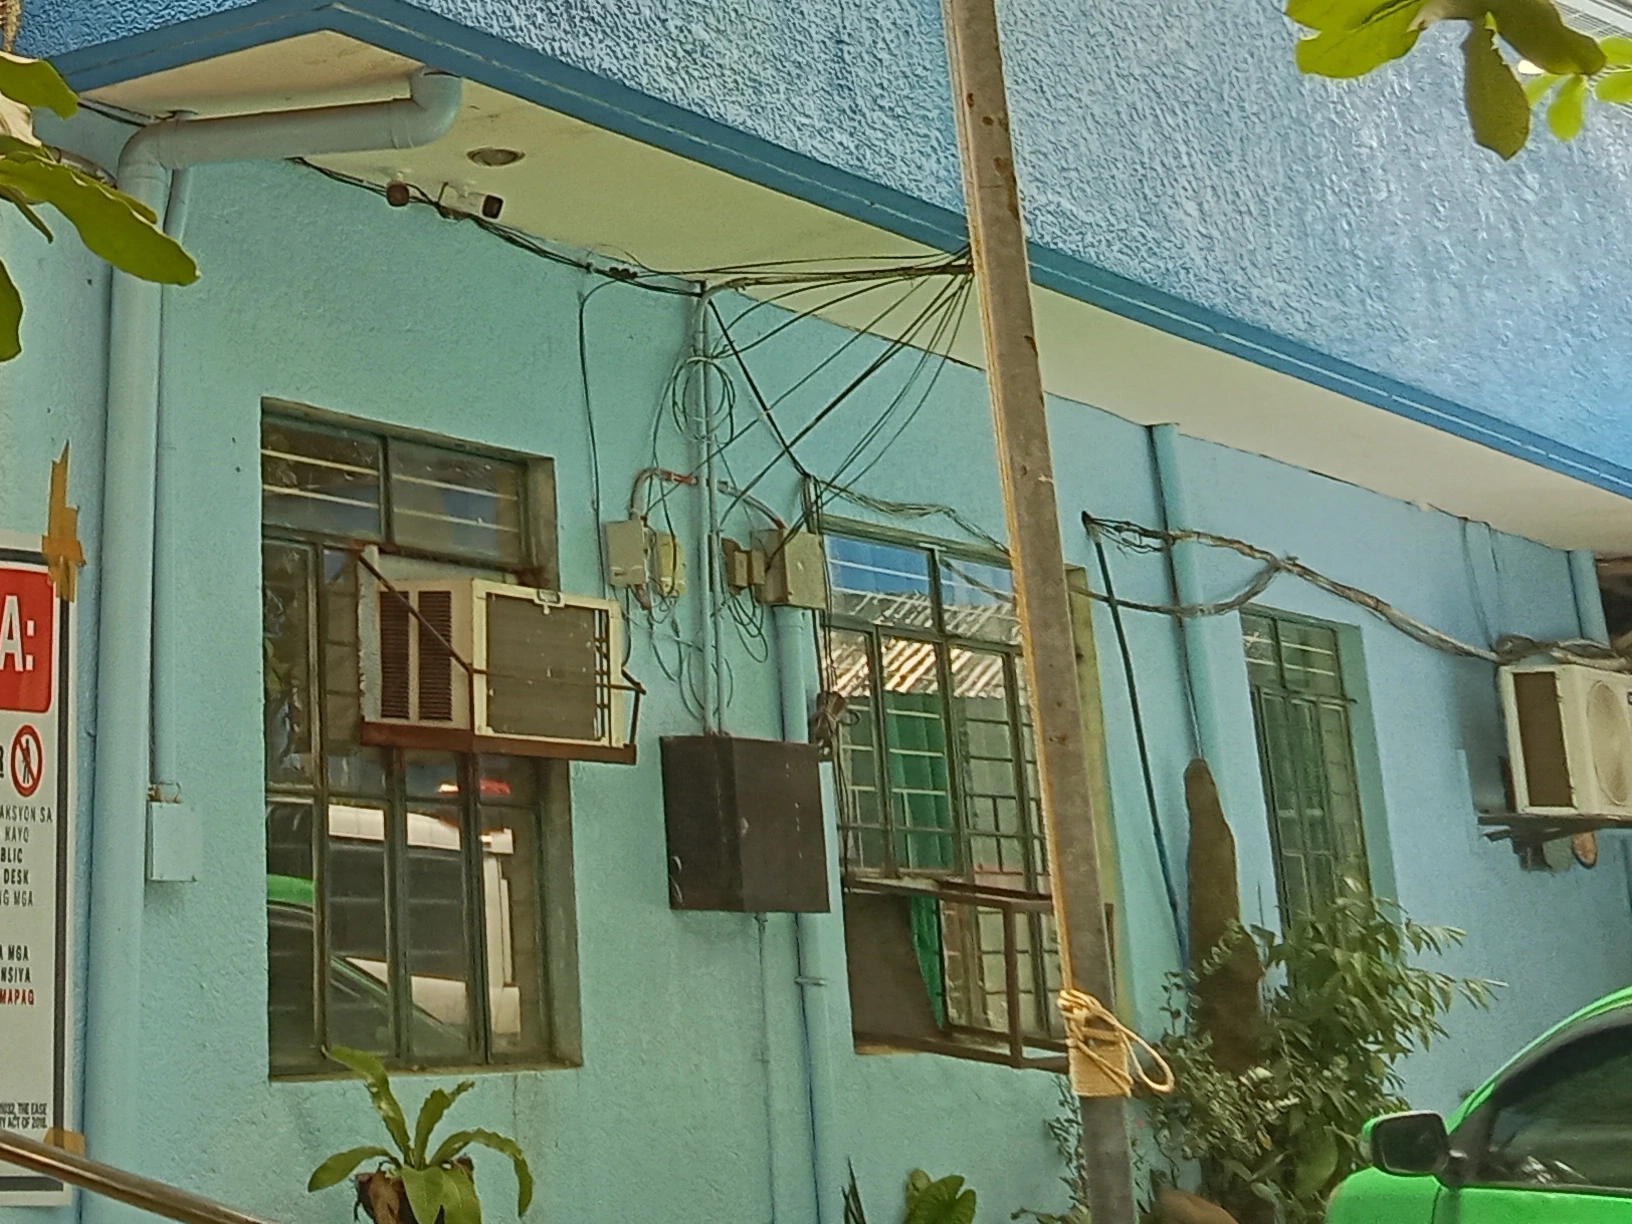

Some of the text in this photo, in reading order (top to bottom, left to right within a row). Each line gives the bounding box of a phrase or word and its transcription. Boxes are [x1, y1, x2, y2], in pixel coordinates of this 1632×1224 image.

[39, 806, 53, 824] SA
[4, 826, 30, 844] KAYO
[3, 867, 30, 885] DESK
[13, 890, 34, 907] MGA
[7, 944, 29, 962] MGA
[17, 1103, 29, 1116] THE
[31, 1103, 48, 1117] EASE
[7, 1116, 21, 1130] ACT
